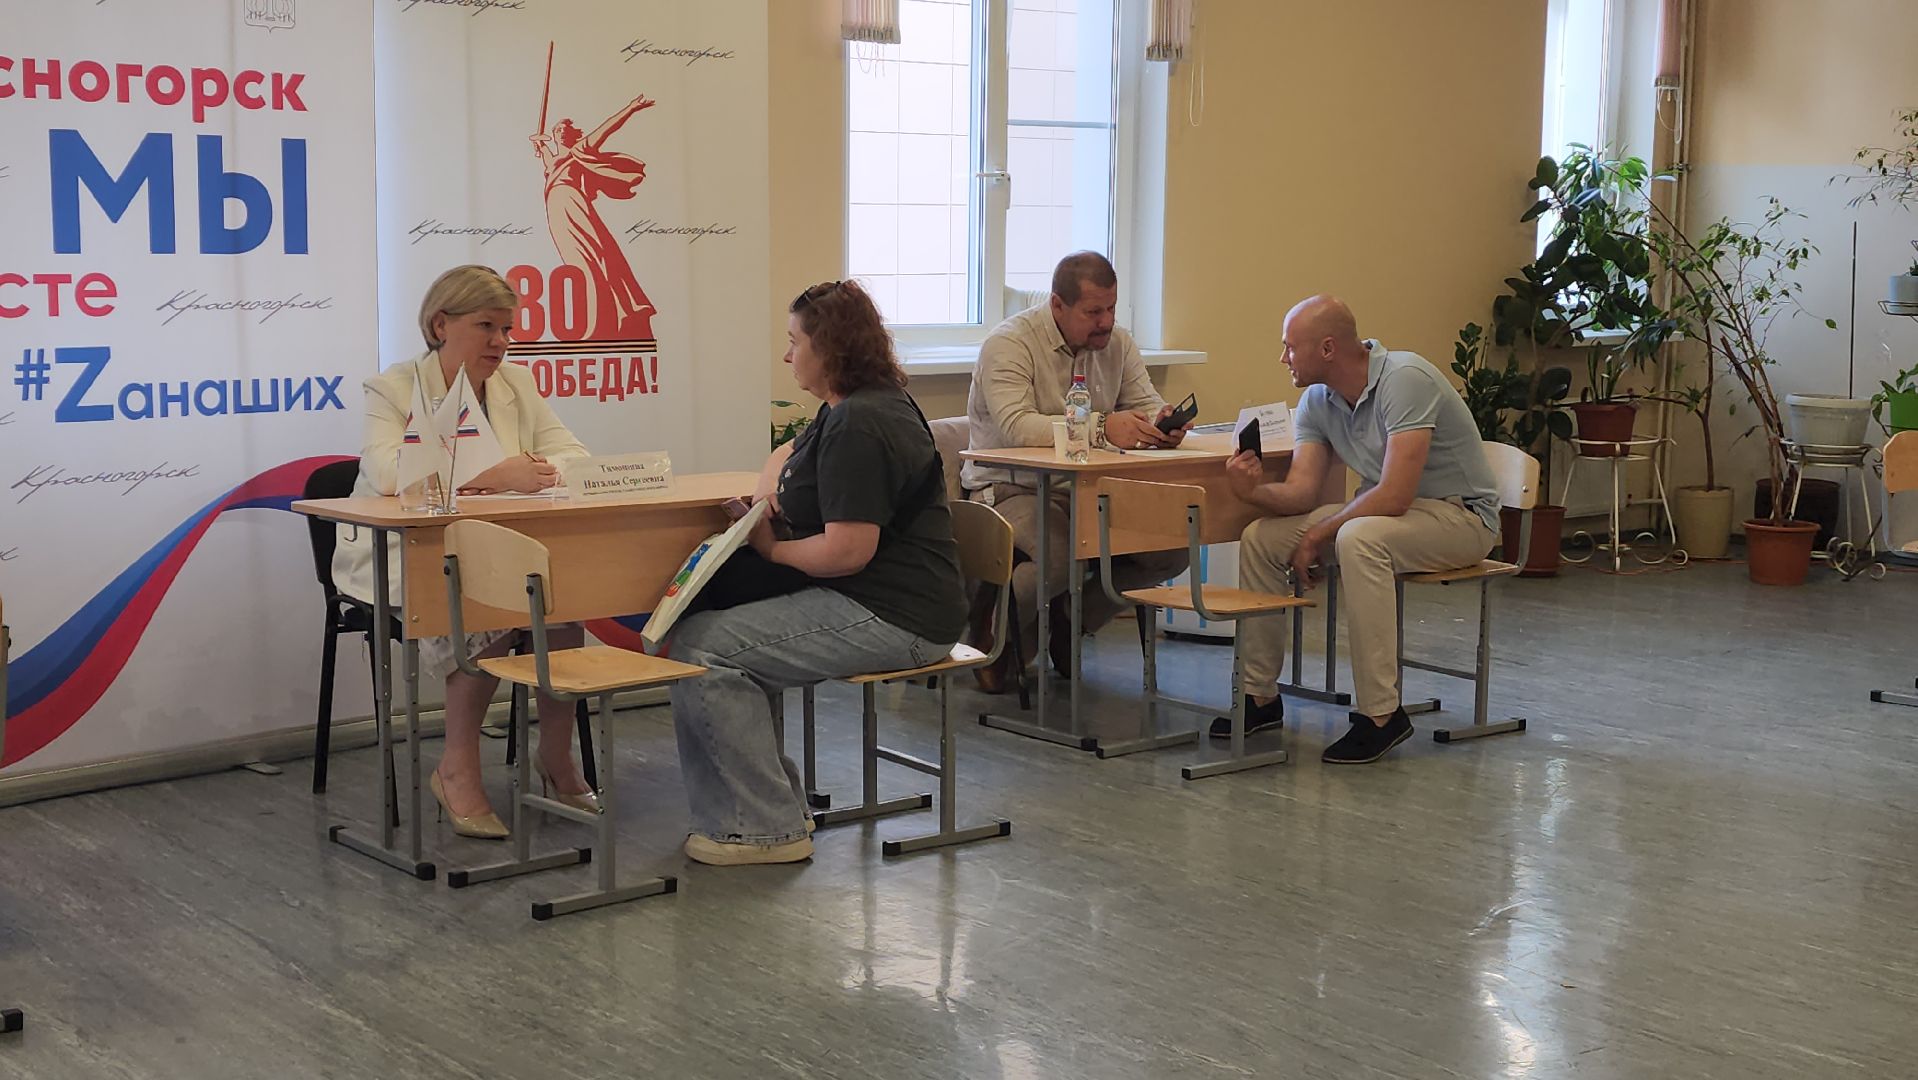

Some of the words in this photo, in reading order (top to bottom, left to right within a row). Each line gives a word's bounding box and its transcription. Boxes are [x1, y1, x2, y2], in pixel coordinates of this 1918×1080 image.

[620, 39, 736, 67] Красногорск
[48, 128, 309, 255] МЫ
[408, 218, 534, 245] Красногорск
[624, 218, 737, 244] Красногорск
[156, 289, 334, 326] Красногорск
[506, 263, 588, 342] 80
[507, 356, 659, 402] ОБЕДА!
[11, 461, 201, 504] Красногорск
